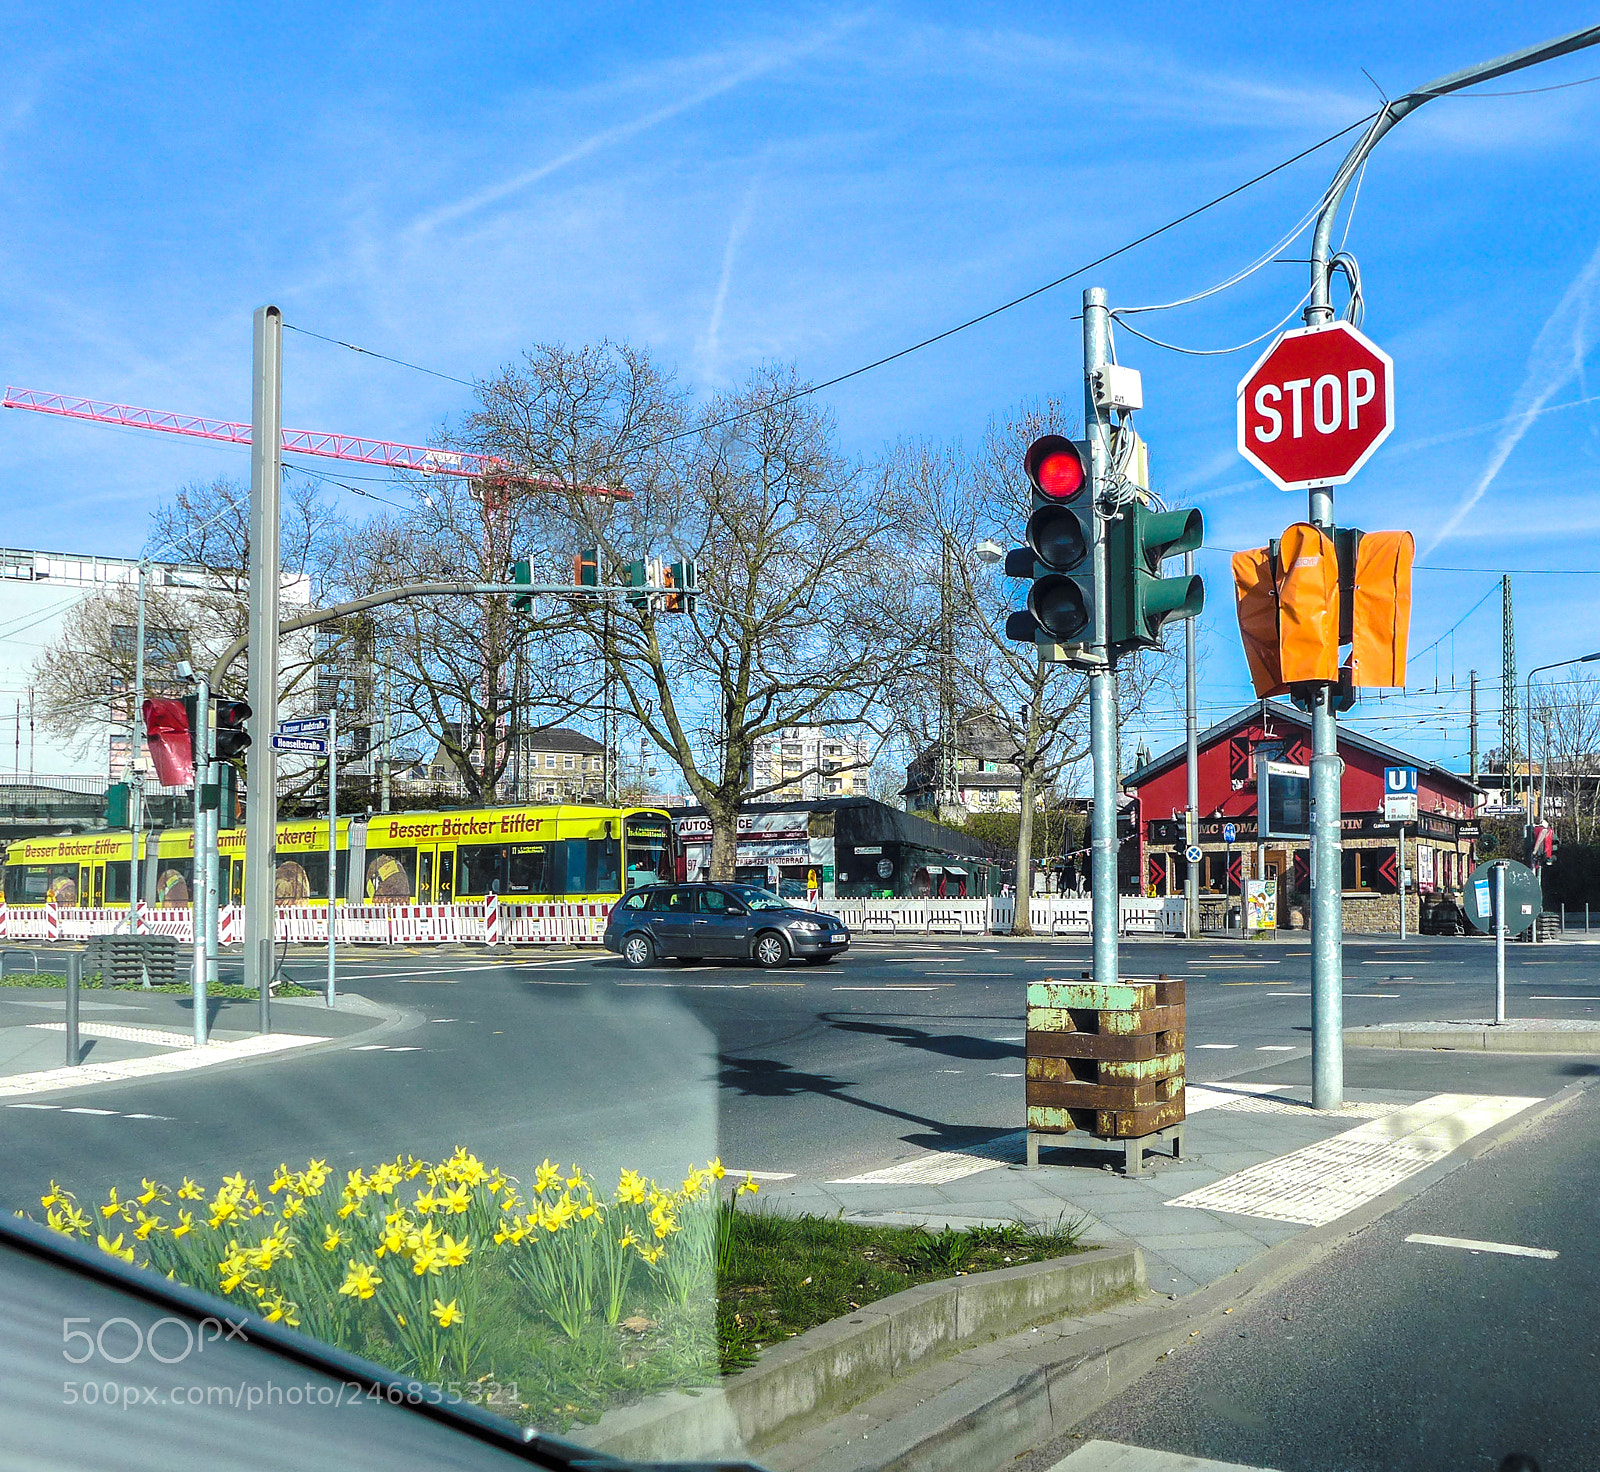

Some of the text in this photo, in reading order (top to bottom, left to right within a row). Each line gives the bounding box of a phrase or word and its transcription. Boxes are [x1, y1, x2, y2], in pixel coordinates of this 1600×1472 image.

[1254, 369, 1376, 443] STOP
[277, 738, 320, 750] Honsellstraße
[1388, 770, 1407, 790] U
[1410, 770, 1417, 790] U
[389, 814, 543, 838] Besser Bäcker Eifler
[25, 845, 57, 857] Besser
[59, 841, 92, 856] Bäcker
[687, 860, 697, 871] 97
